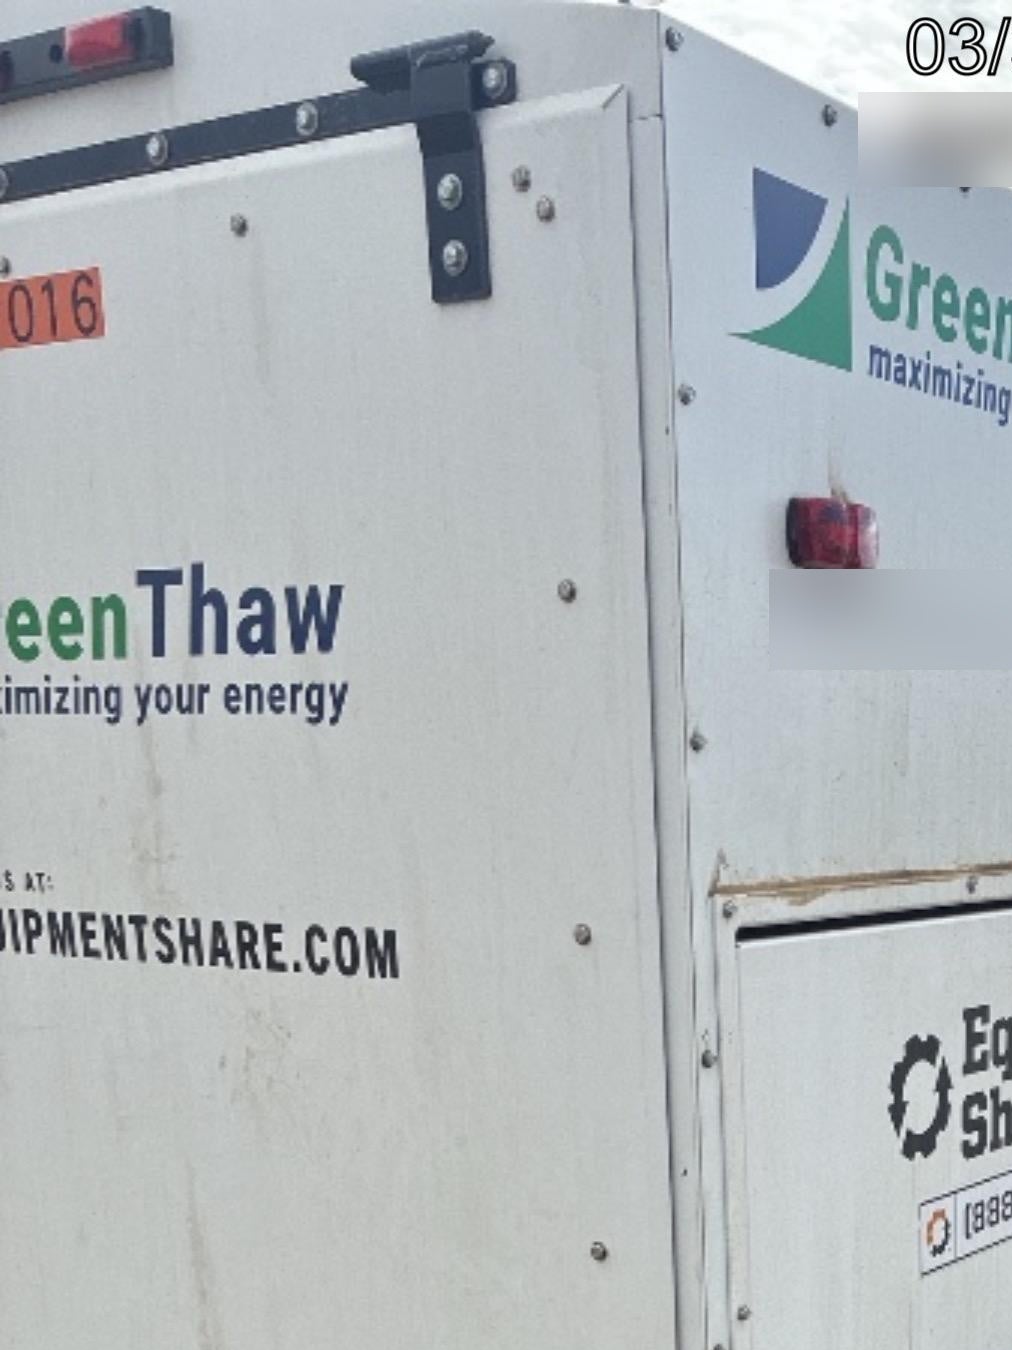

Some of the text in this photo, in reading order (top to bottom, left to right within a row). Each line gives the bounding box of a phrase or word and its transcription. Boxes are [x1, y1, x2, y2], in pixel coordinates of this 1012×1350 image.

[8, 271, 97, 343] 016
[868, 343, 1012, 427] maximizing
[134, 683, 210, 727] your
[223, 682, 348, 727] energy
